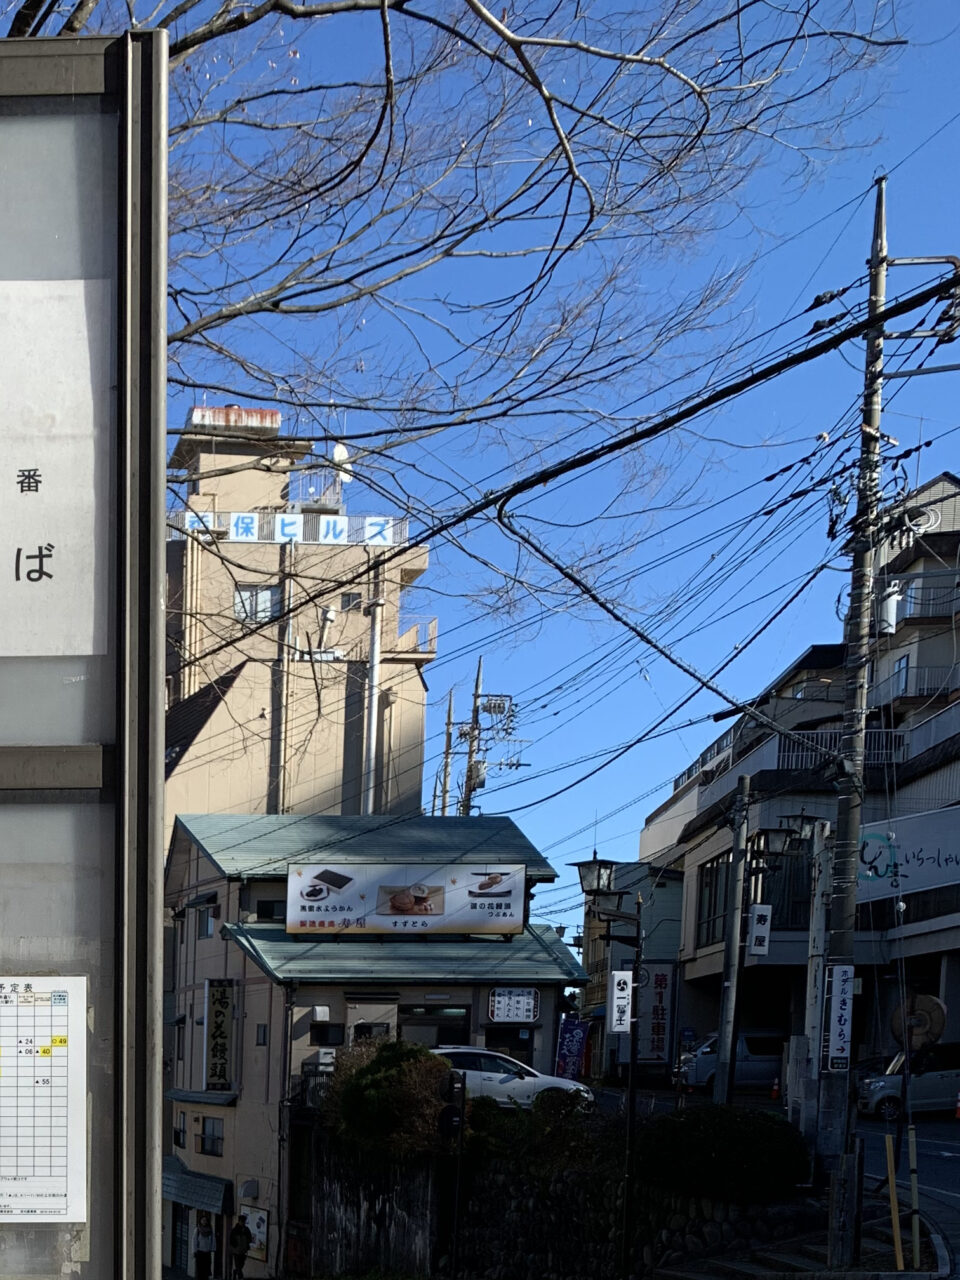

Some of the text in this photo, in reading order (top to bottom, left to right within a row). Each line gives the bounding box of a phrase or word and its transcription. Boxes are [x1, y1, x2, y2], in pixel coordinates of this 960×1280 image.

[754, 914, 768, 947] 寿屋
[210, 988, 230, 1082] 湯の花饅頭
[650, 973, 668, 1053] 第1駐車場
[837, 970, 850, 1041] ホテルきむら
